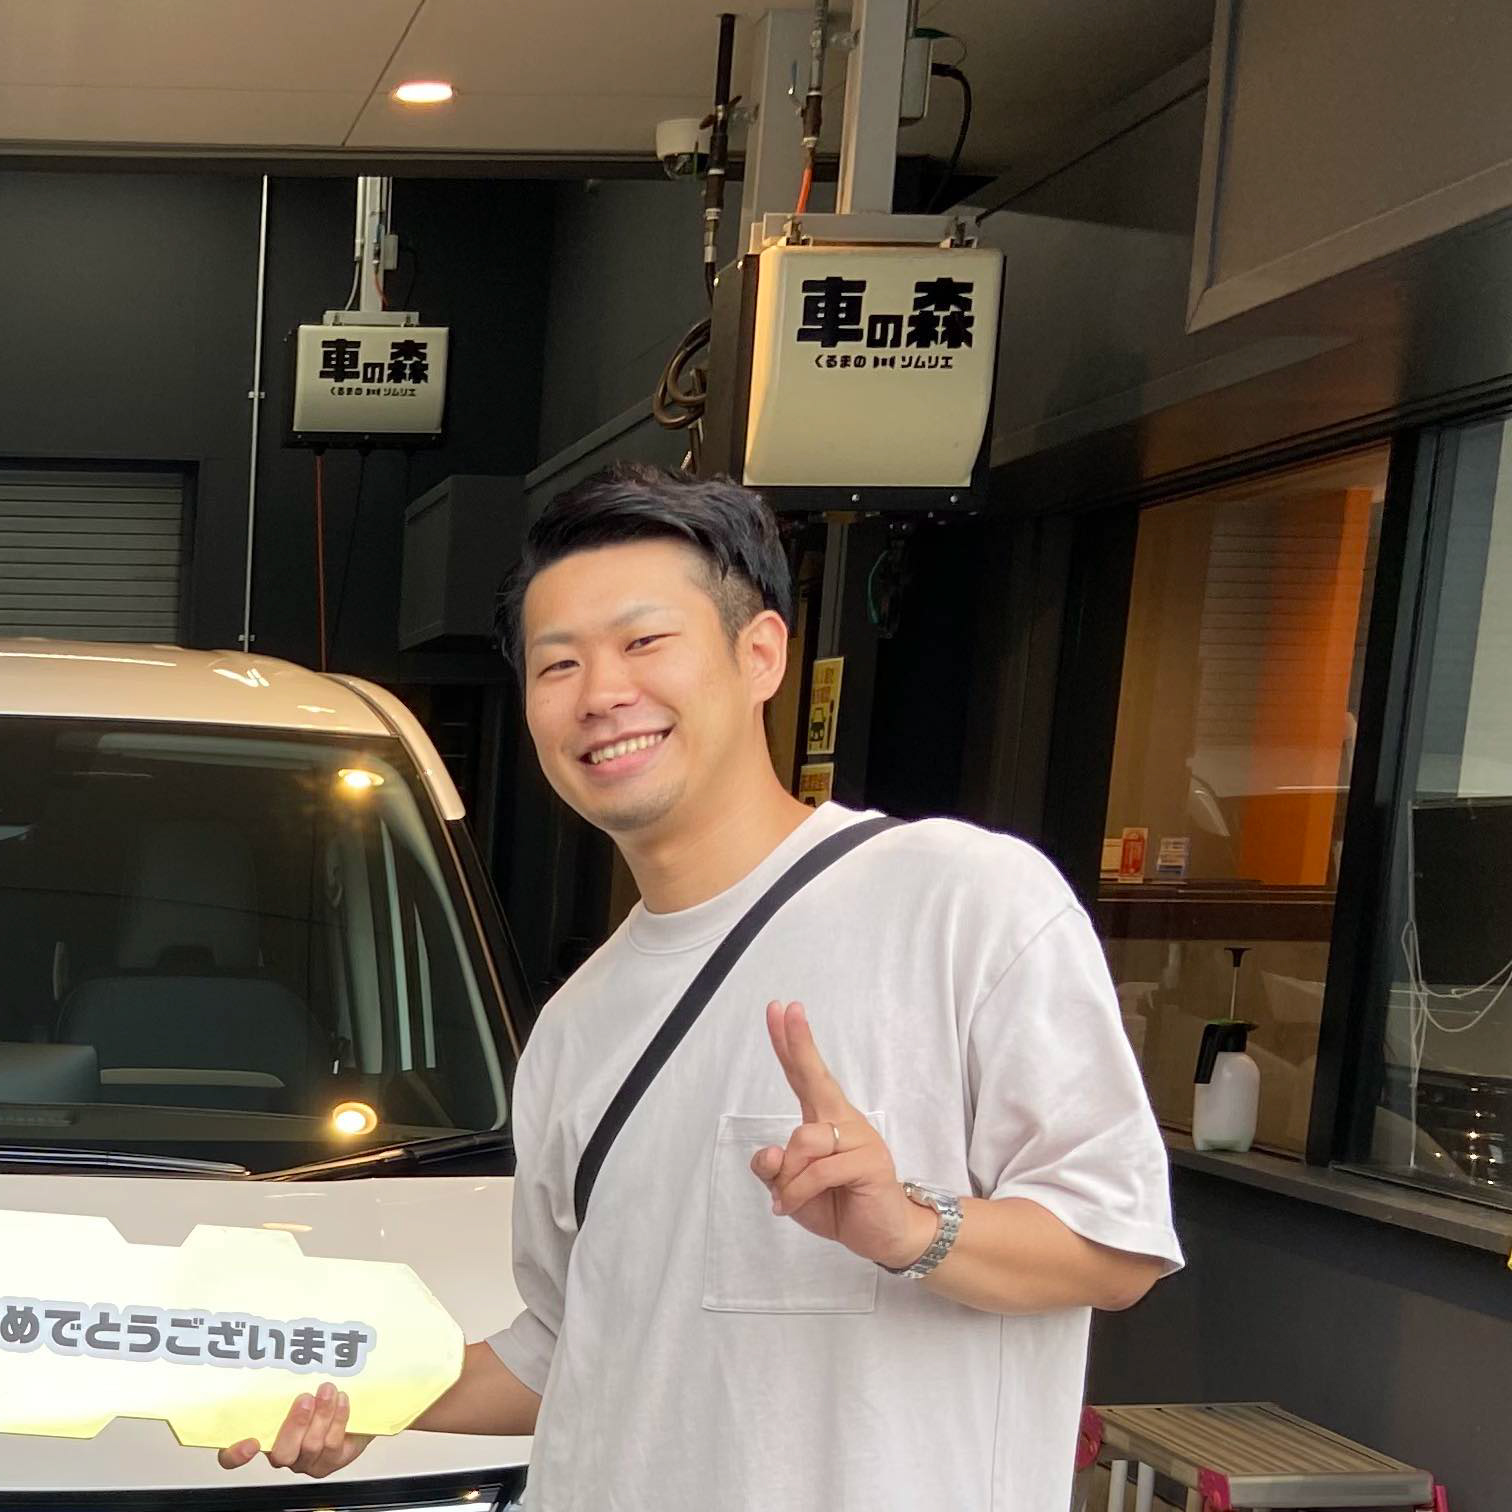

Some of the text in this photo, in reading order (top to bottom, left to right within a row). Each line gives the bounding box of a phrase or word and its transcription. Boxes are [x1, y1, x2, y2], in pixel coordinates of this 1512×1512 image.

[796, 276, 975, 350] 車の森
[319, 338, 430, 384] 車の森
[814, 354, 953, 370] くるまの ソムリエ
